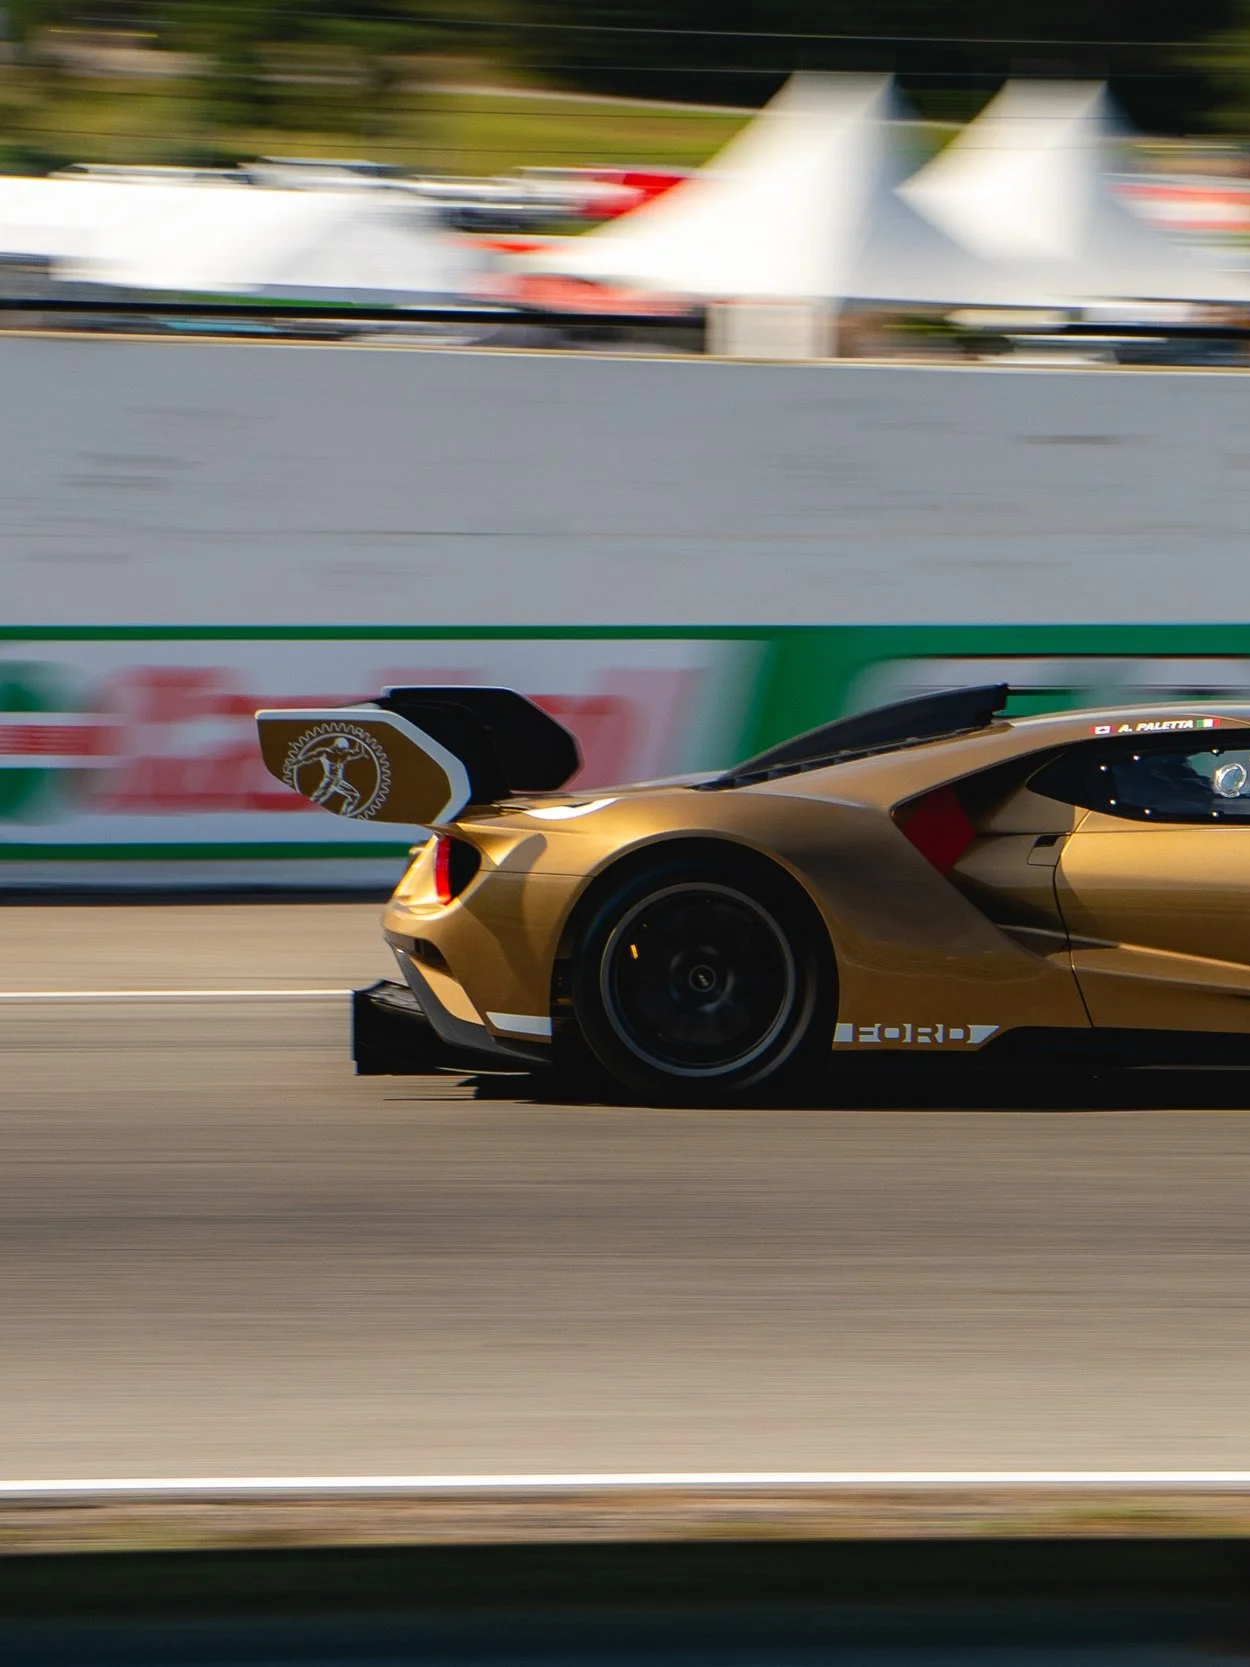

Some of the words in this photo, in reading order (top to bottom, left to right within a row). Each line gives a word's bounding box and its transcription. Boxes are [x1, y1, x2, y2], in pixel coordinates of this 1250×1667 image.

[1118, 724, 1132, 733] A.
[1136, 720, 1194, 732] PALETTA
[852, 1023, 971, 1043] FORD
